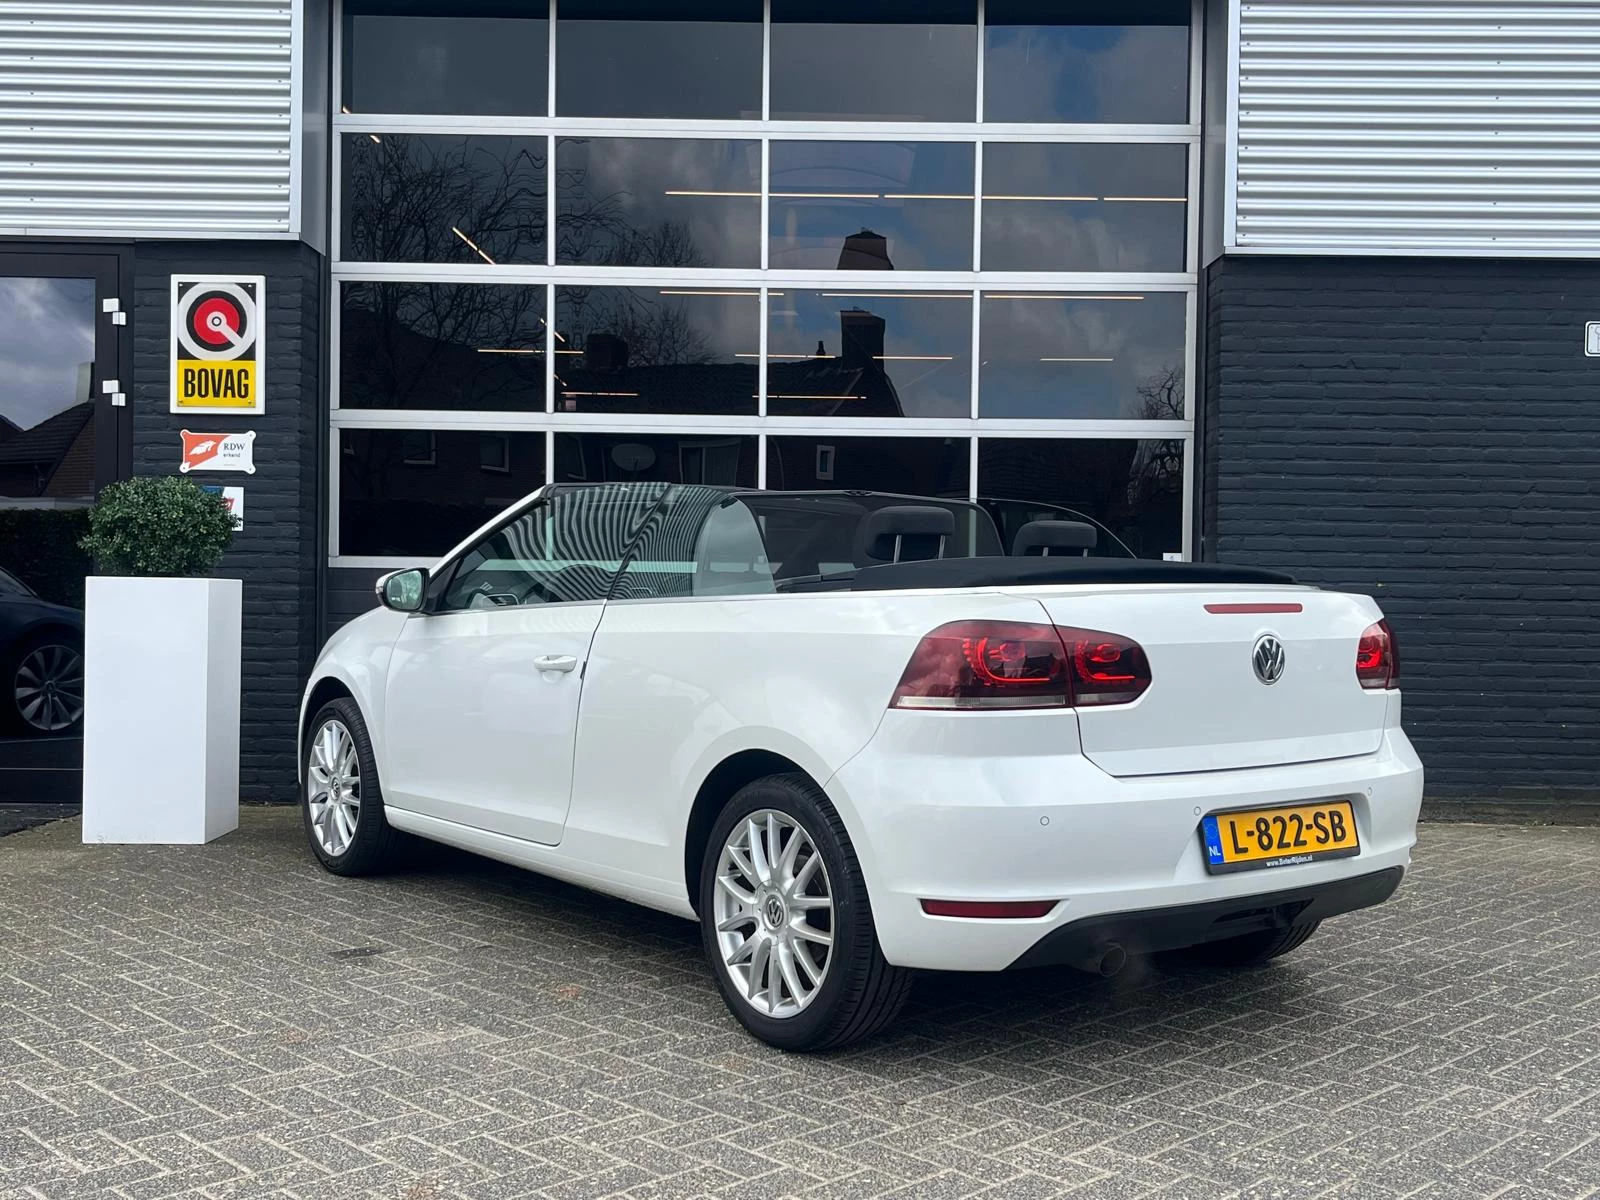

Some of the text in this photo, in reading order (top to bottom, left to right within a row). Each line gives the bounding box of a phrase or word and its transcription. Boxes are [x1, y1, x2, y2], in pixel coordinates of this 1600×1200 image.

[184, 368, 249, 399] BOVAG
[223, 442, 245, 451] RDW
[1229, 810, 1347, 854] L-822-SB
[1209, 846, 1221, 857] NL
